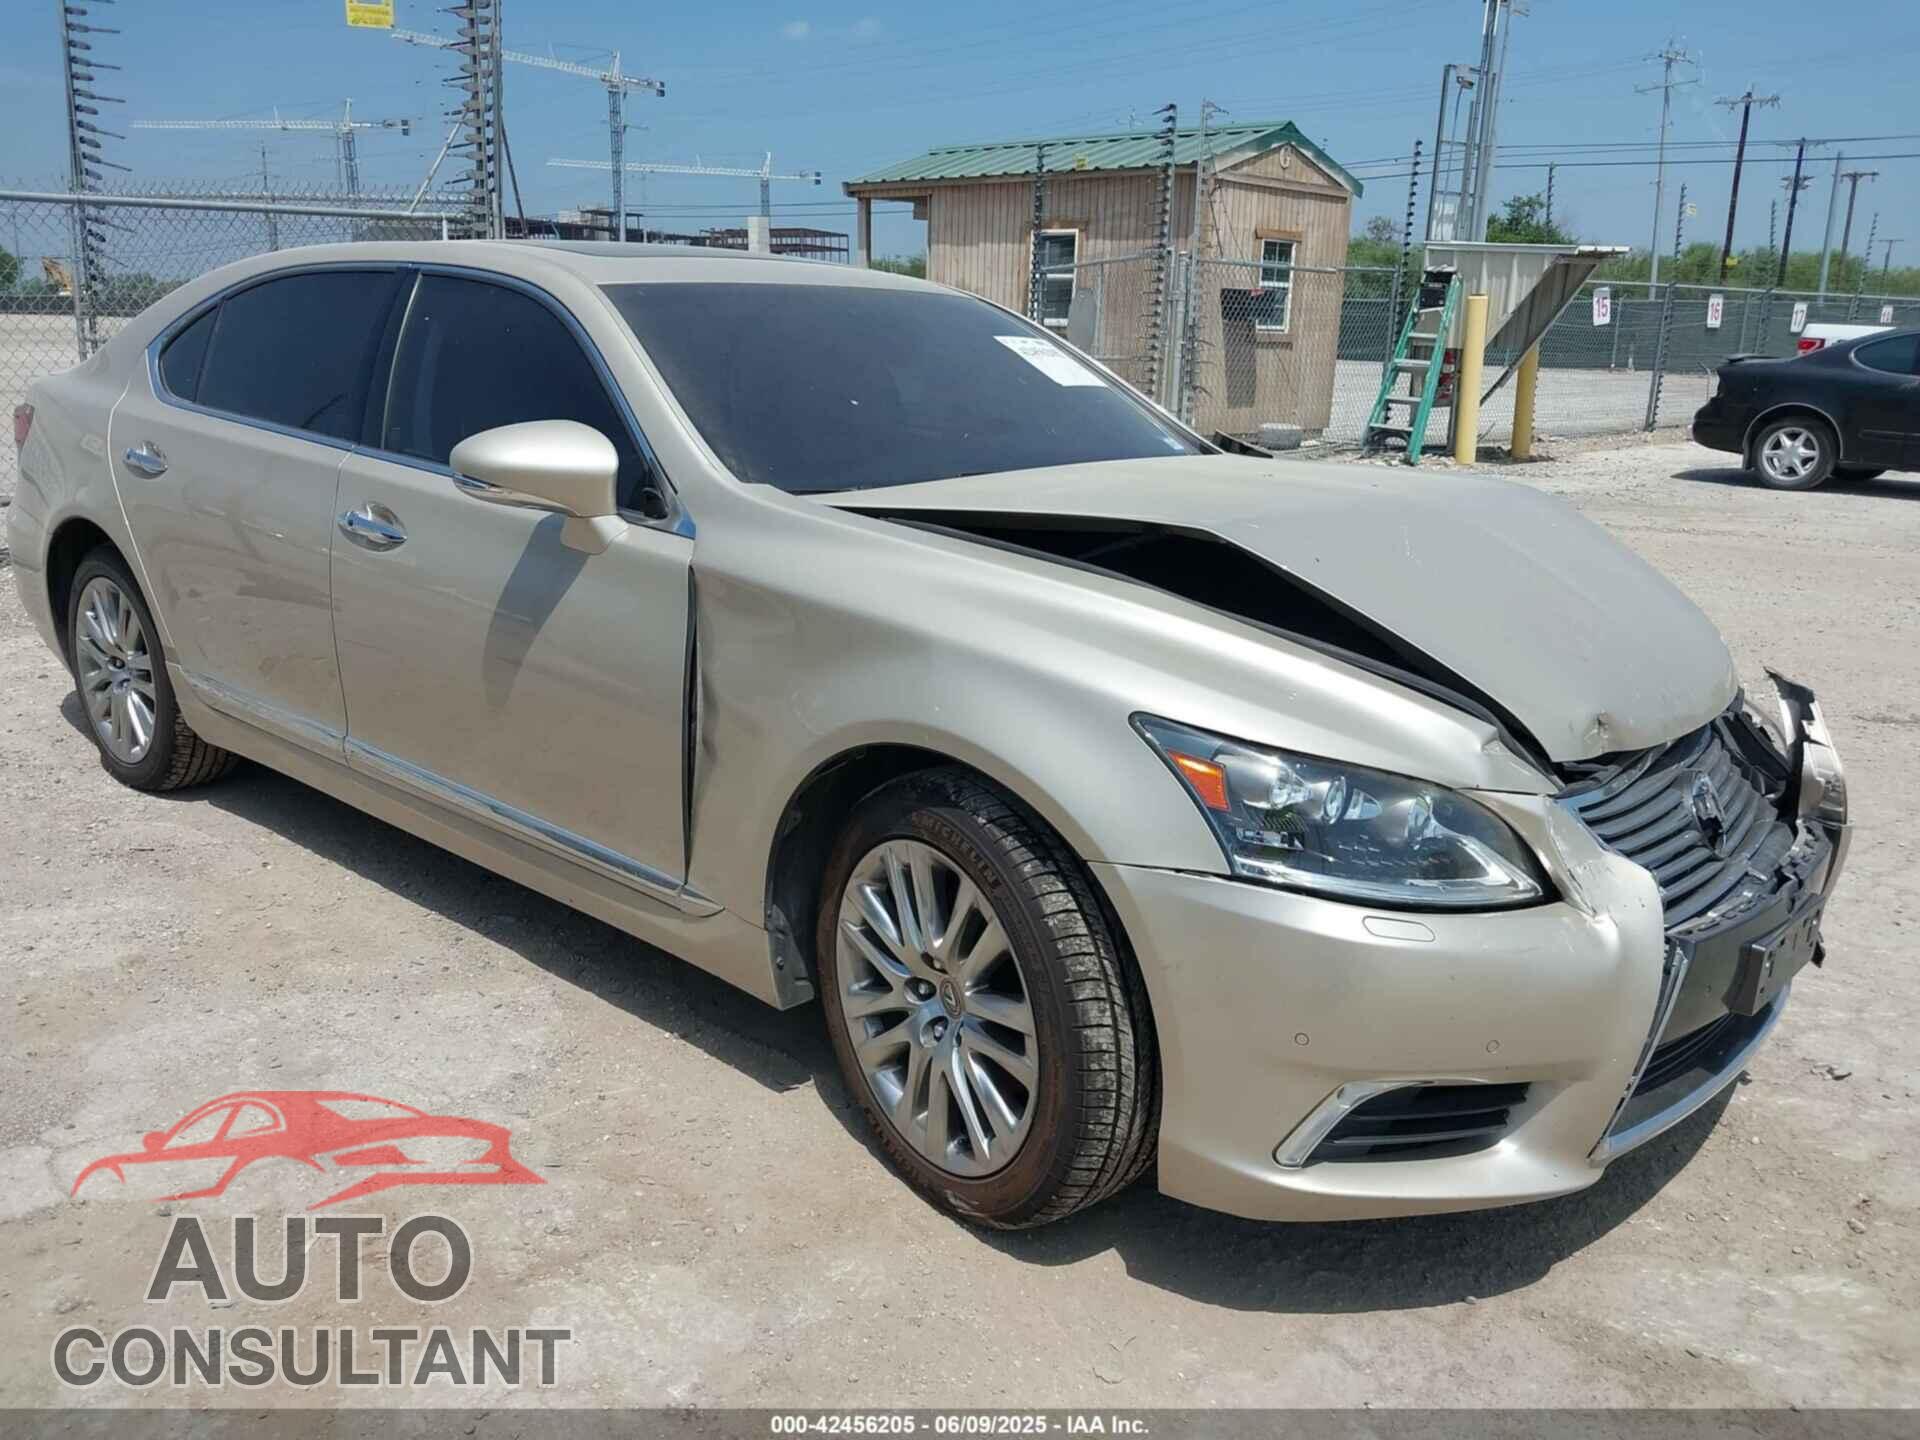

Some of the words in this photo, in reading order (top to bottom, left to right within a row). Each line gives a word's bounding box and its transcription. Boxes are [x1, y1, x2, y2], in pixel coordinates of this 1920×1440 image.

[1596, 296, 1608, 319] 15
[1711, 302, 1721, 321] 16
[1793, 309, 1805, 329] 17
